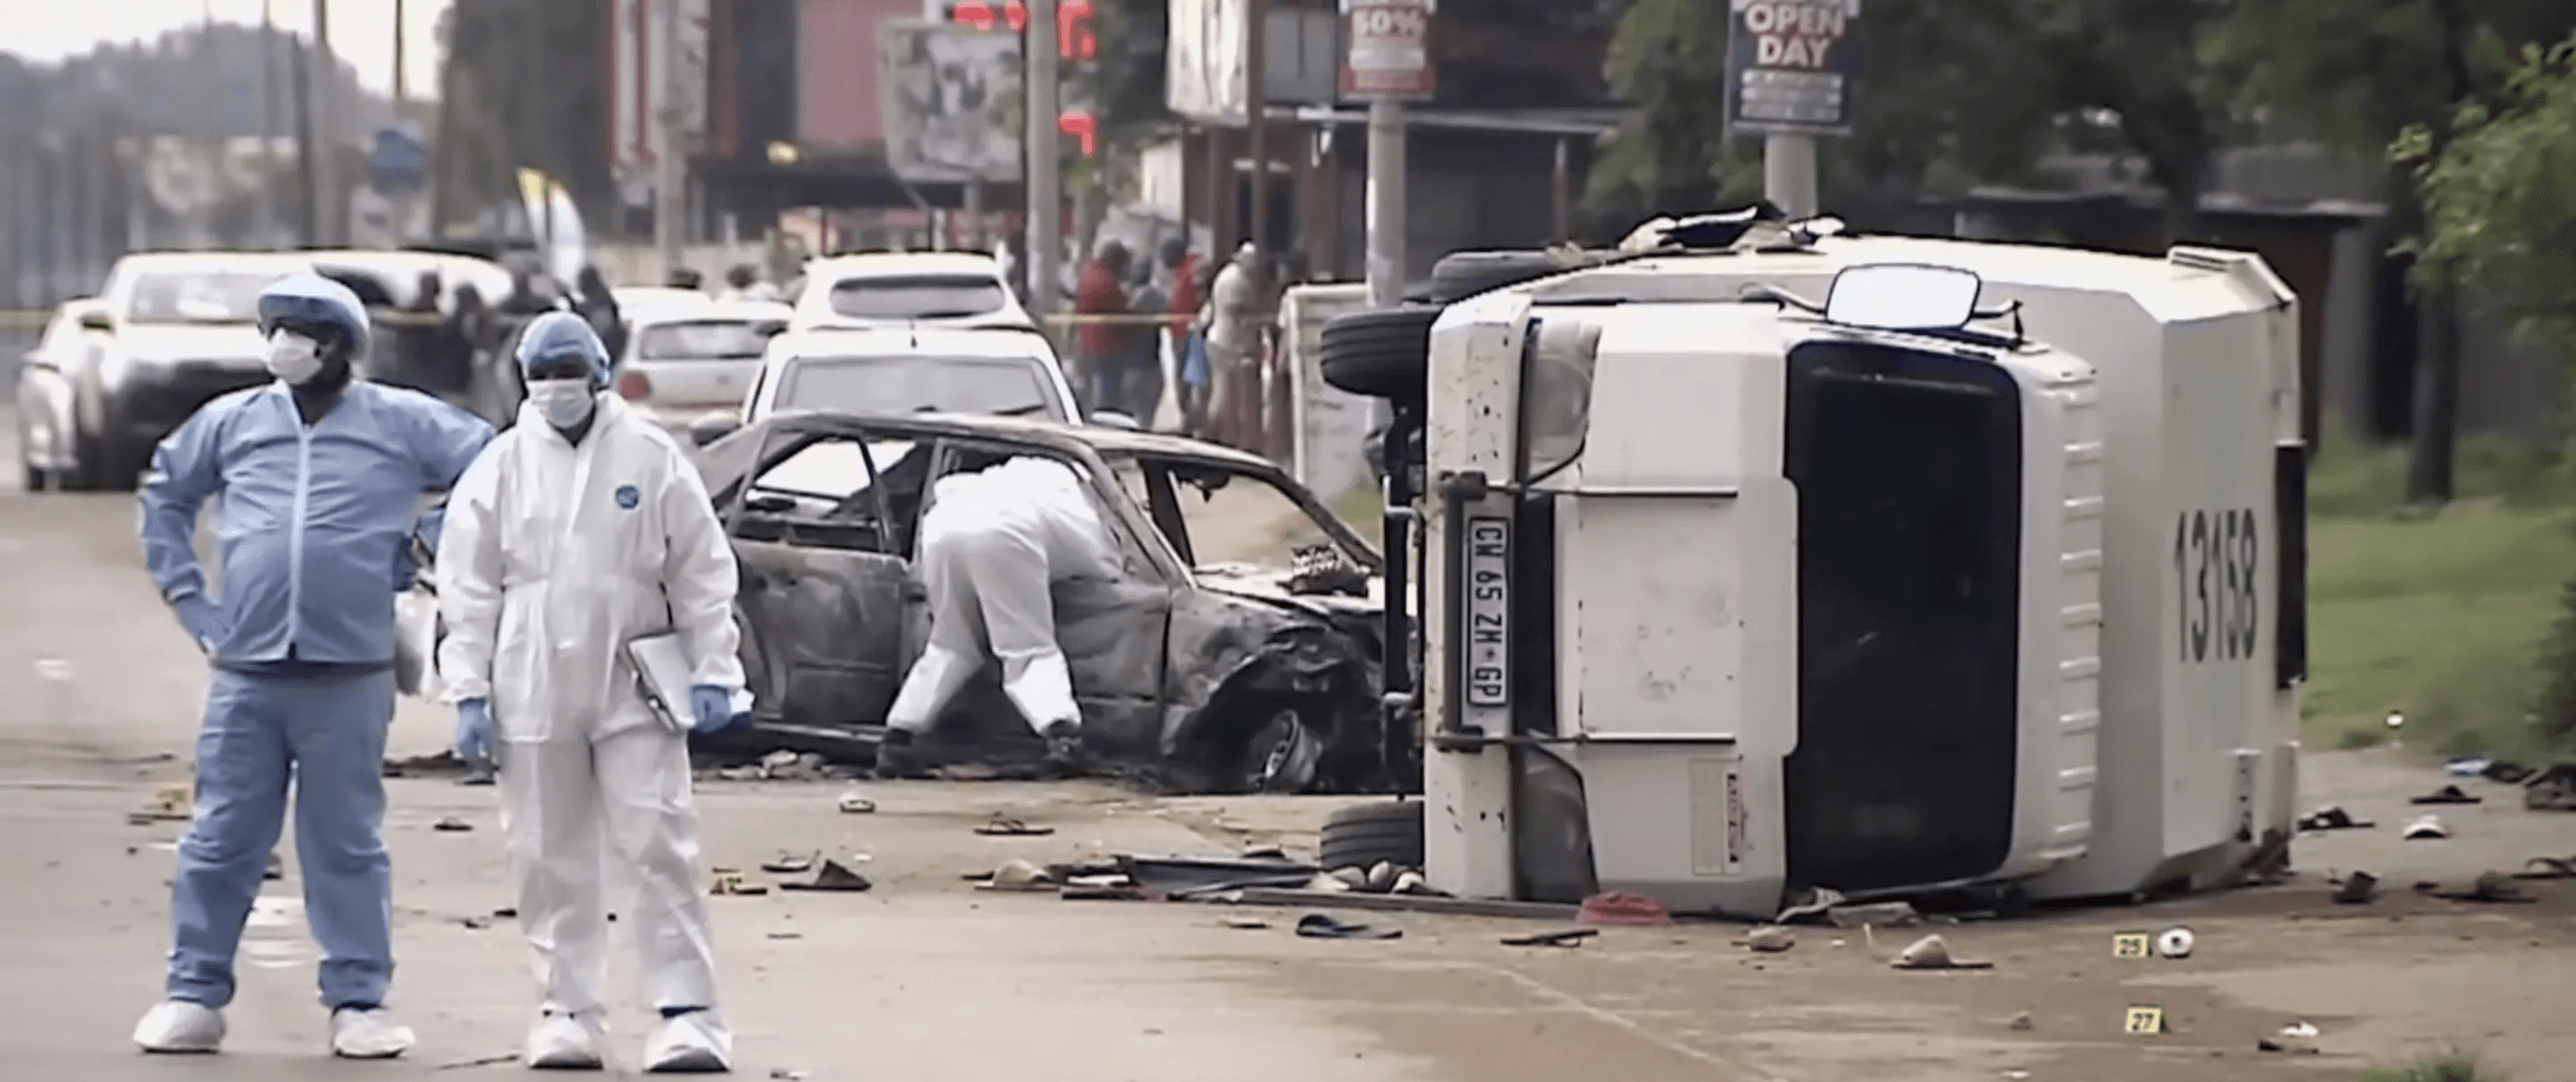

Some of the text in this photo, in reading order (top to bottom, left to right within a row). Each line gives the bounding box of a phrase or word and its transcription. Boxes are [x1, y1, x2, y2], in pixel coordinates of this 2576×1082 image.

[1745, 4, 1845, 36] OPEN
[1758, 34, 1830, 67] DAY
[1475, 570, 1503, 601] 65
[2173, 507, 2257, 663] 13158
[1474, 667, 1503, 697] GP
[2131, 1012, 2155, 1032] 27
